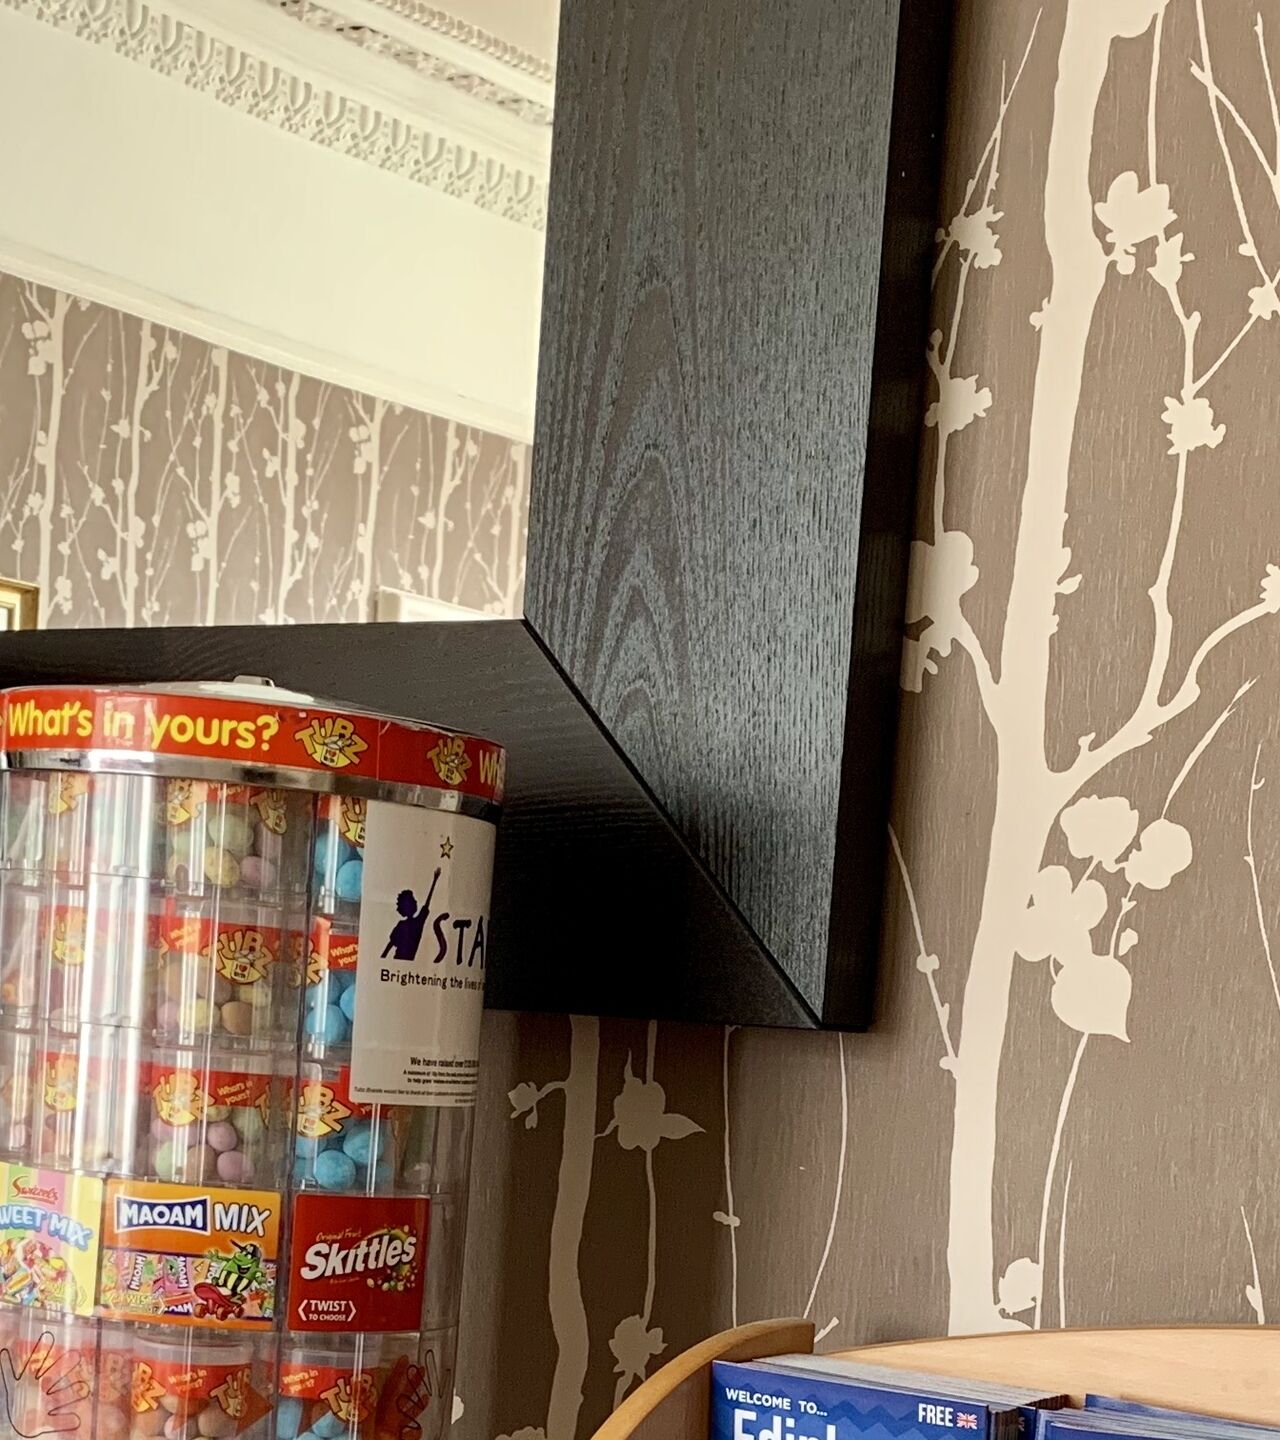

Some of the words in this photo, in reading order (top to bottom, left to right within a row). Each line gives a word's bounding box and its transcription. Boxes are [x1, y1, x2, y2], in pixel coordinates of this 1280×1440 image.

[9, 703, 94, 738] What's
[104, 710, 134, 741] in
[149, 712, 280, 752] yours?
[294, 716, 370, 766] TUBZ
[381, 969, 448, 990] Brightening
[450, 976, 464, 989] the
[49, 1213, 92, 1247] MIX
[121, 1202, 204, 1229] MAOAM
[214, 1202, 271, 1236] MIX
[130, 1253, 147, 1291] MAOAM
[300, 1235, 417, 1280] Skittles
[309, 1300, 347, 1312] TWIST
[726, 1388, 791, 1410] WELCOME
[799, 1400, 828, 1417] TO...
[918, 1403, 954, 1427] FREE
